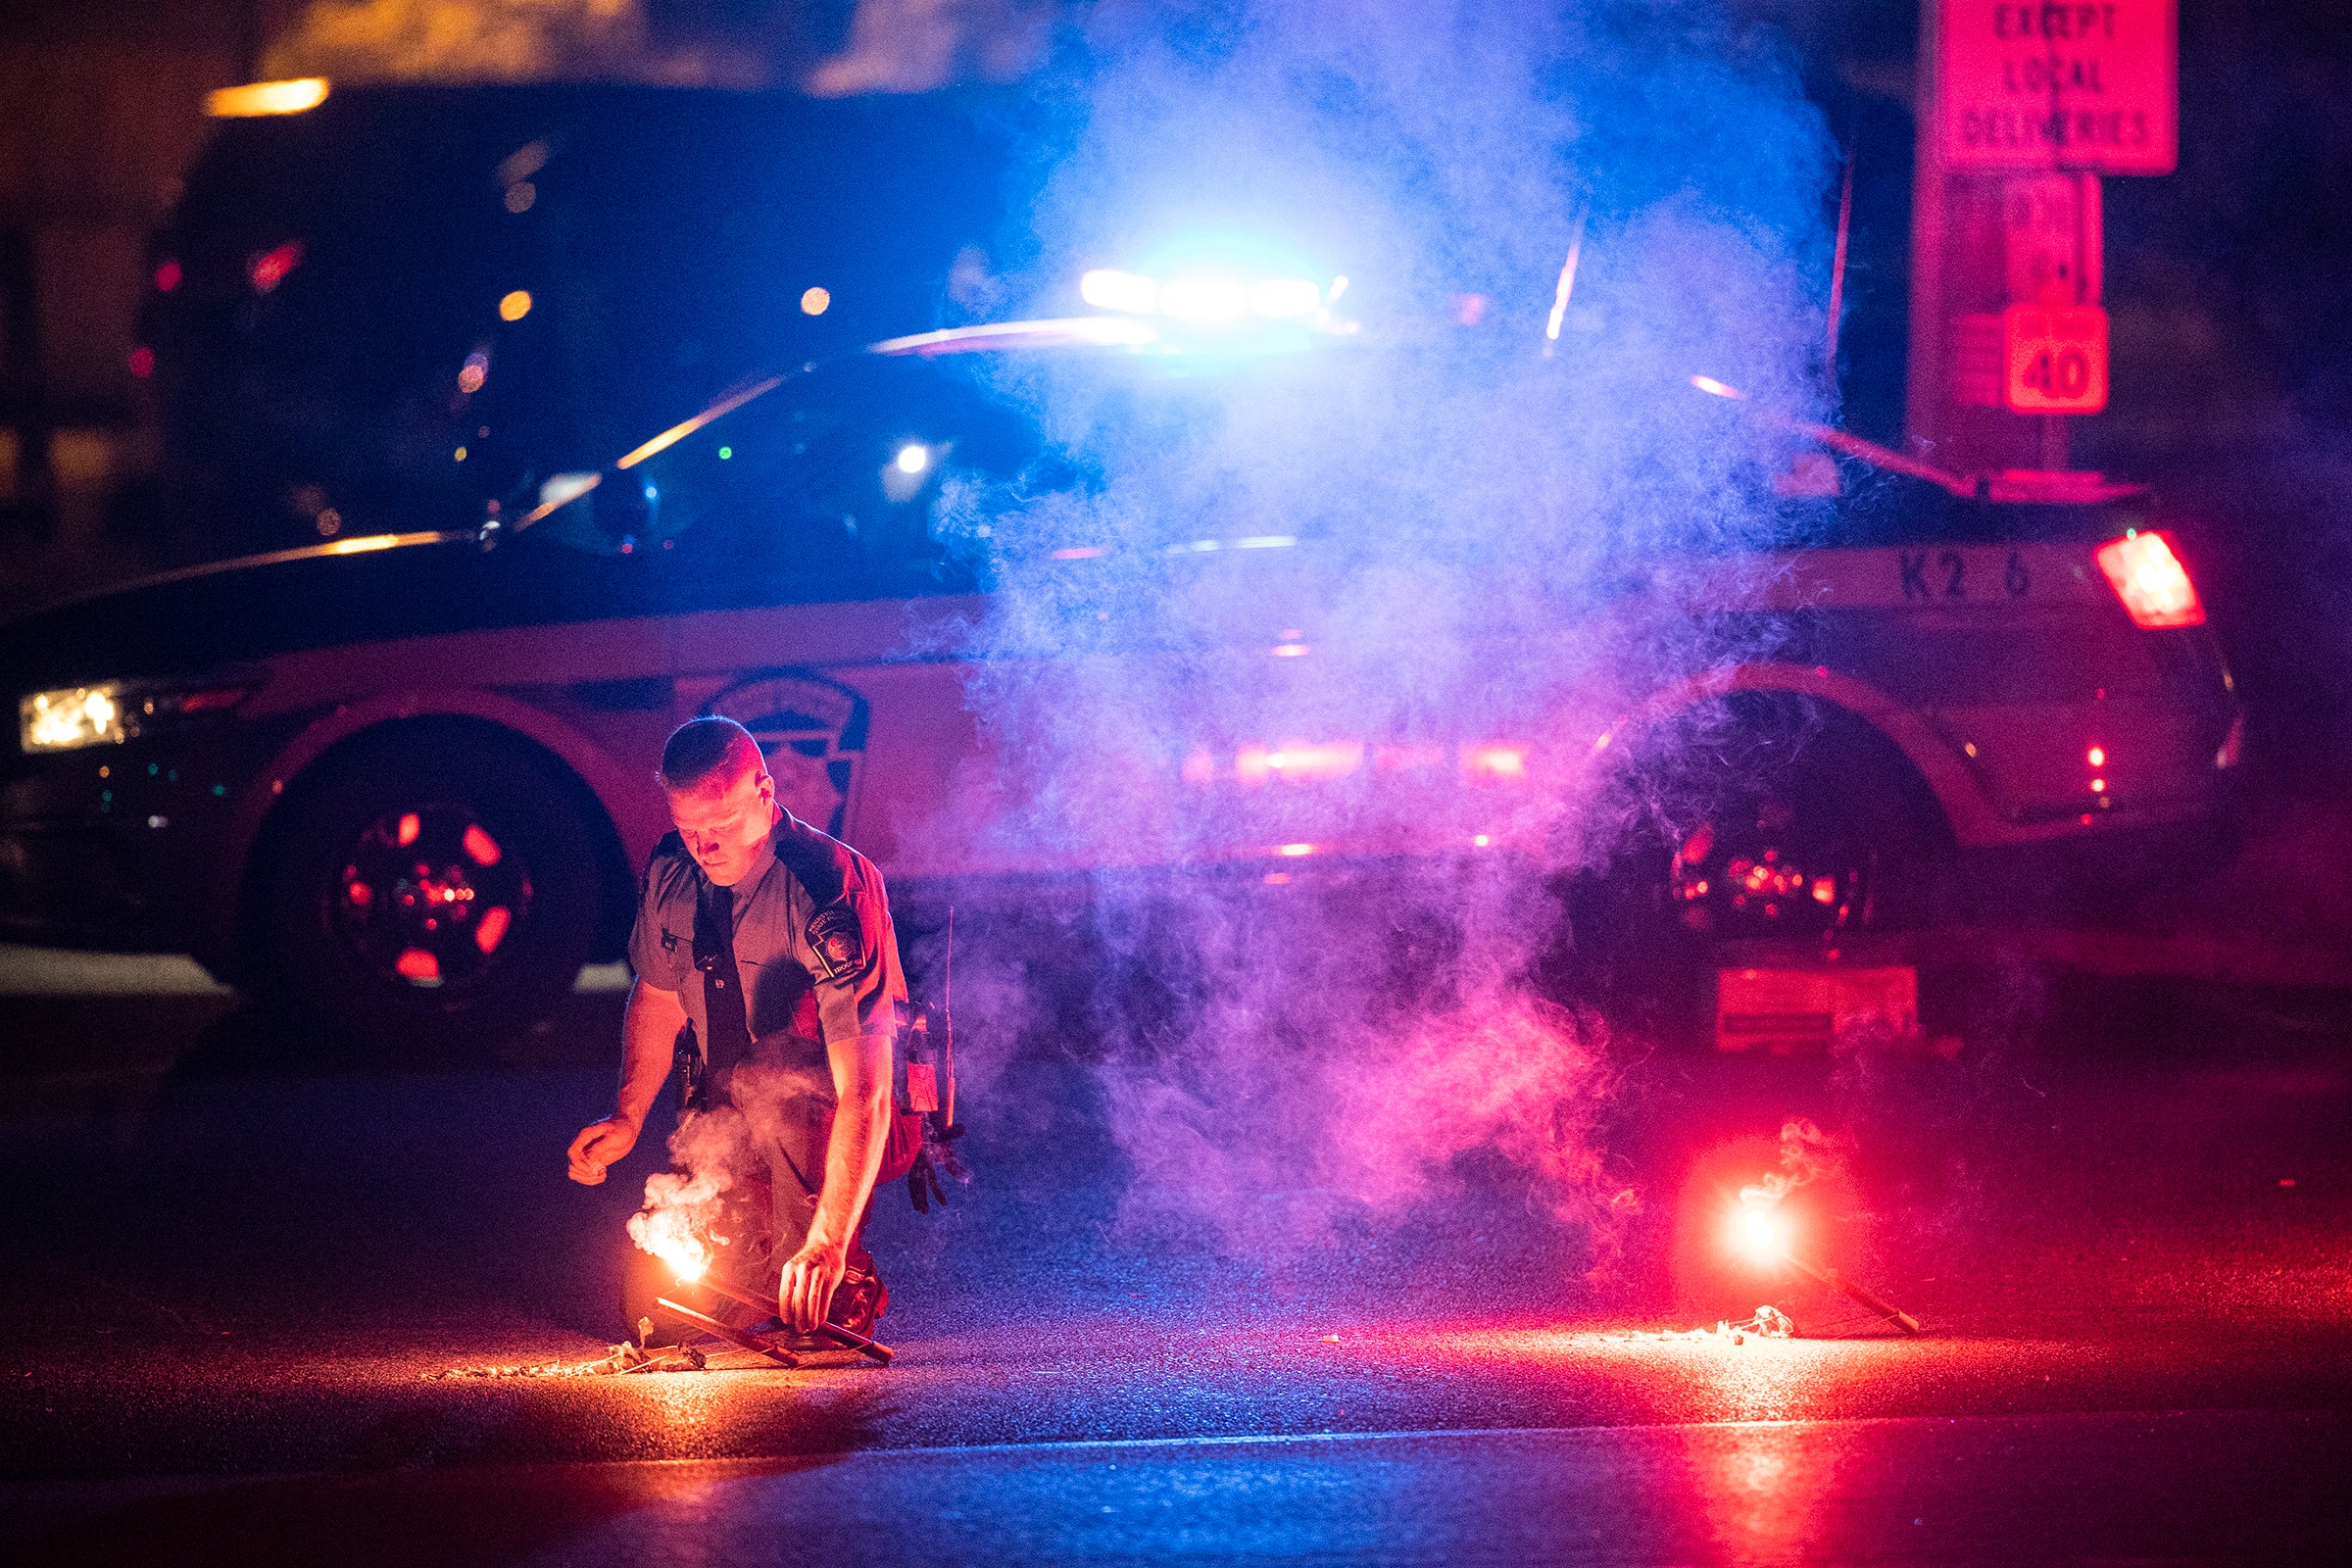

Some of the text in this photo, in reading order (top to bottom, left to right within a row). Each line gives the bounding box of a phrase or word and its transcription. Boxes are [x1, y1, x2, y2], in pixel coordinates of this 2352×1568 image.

[1994, 2, 2116, 39] EXCEPT
[2005, 56, 2103, 94] LOCAL
[1962, 109, 2149, 146] DELIVERIES
[2022, 349, 2091, 400] 40
[1900, 549, 1966, 599] K2
